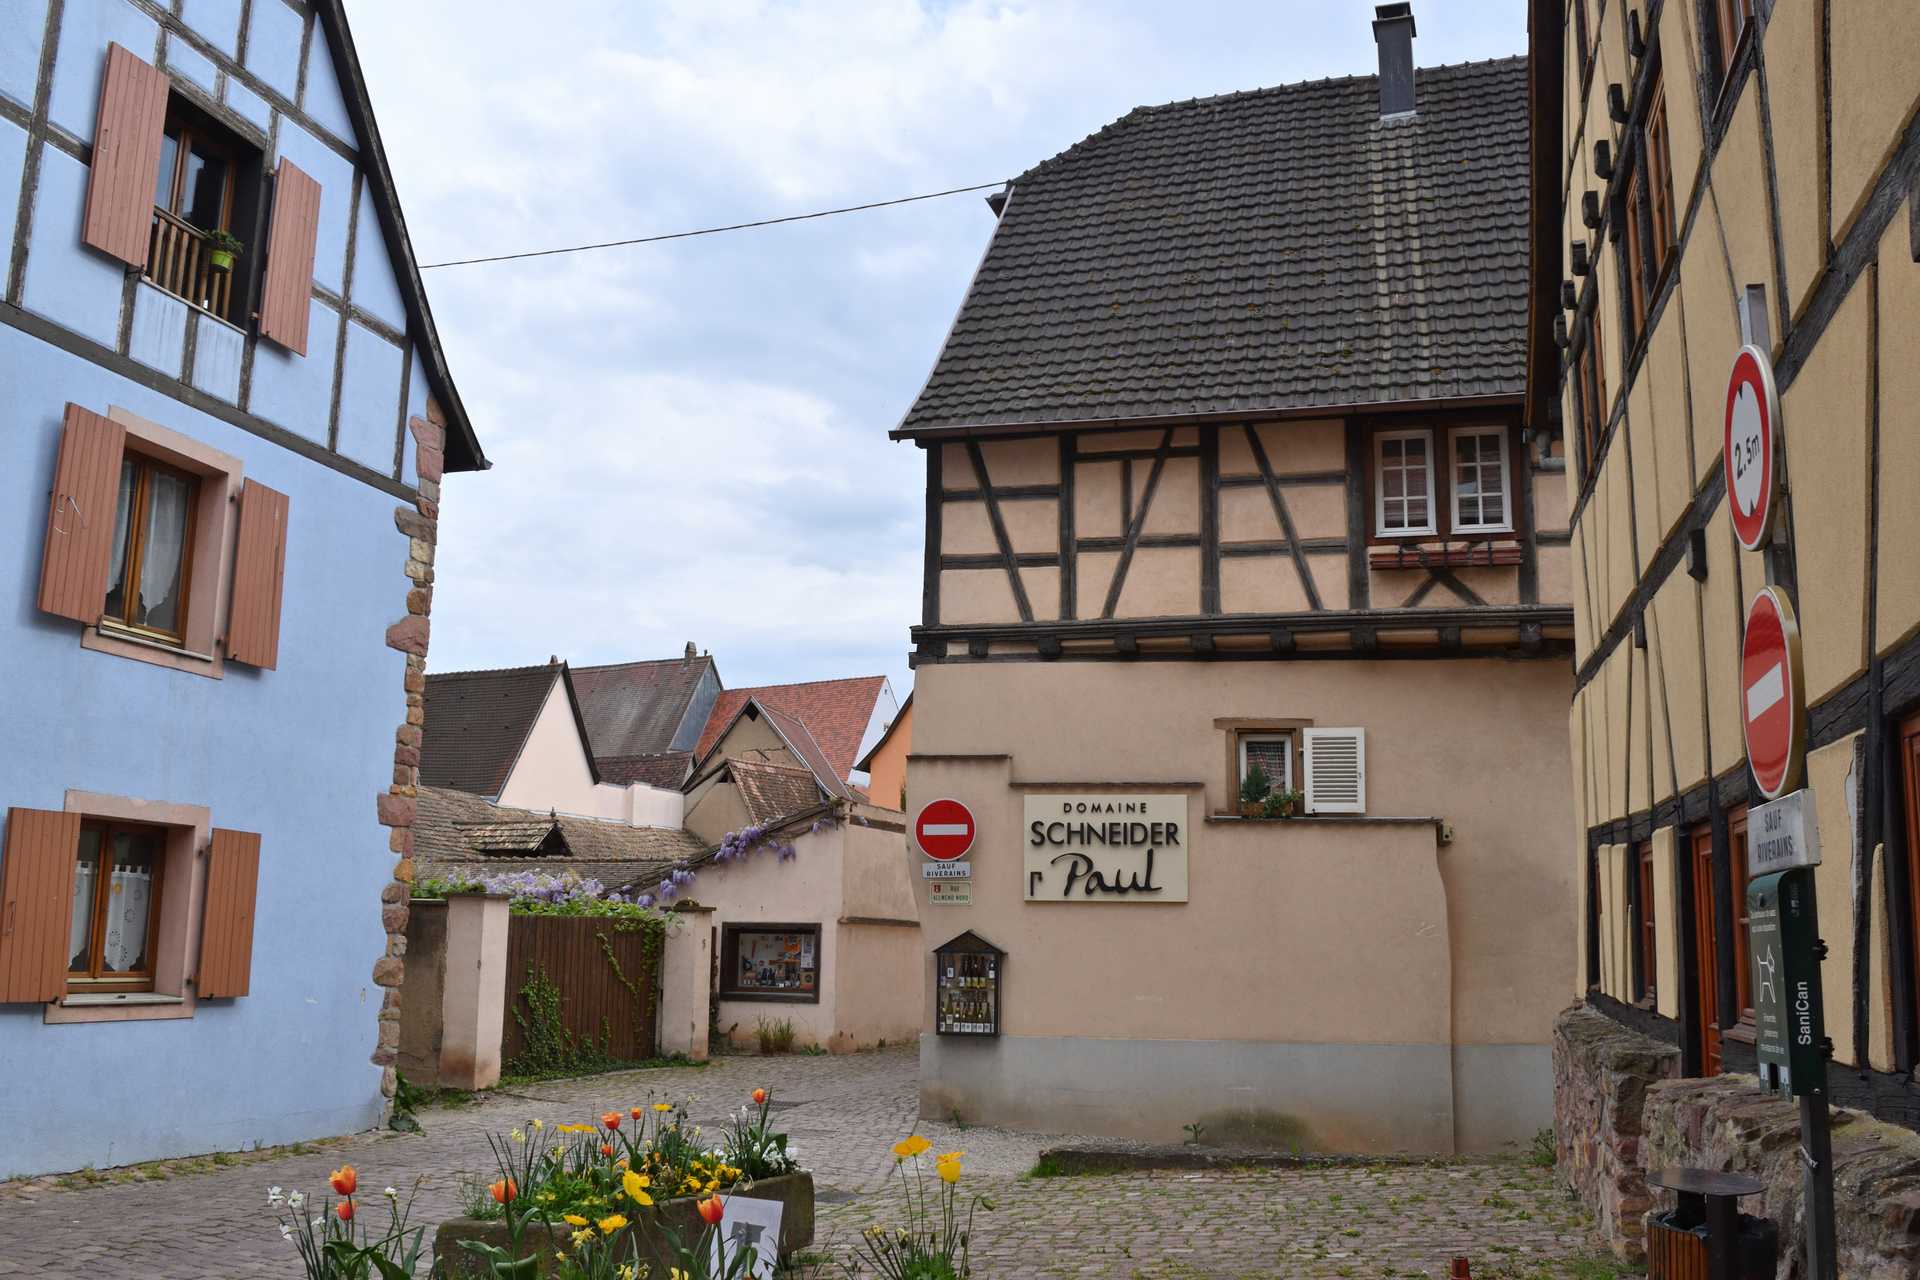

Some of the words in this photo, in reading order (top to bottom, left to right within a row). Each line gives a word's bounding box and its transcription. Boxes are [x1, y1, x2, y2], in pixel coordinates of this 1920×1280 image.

[1063, 802, 1148, 814] DOMAINE
[1764, 808, 1782, 834] SAUF
[1030, 820, 1180, 847] SCHNEIDER
[1757, 834, 1794, 863] RIVERAINS
[1050, 848, 1163, 897] Paul
[1795, 981, 1812, 1046] SaniCan
